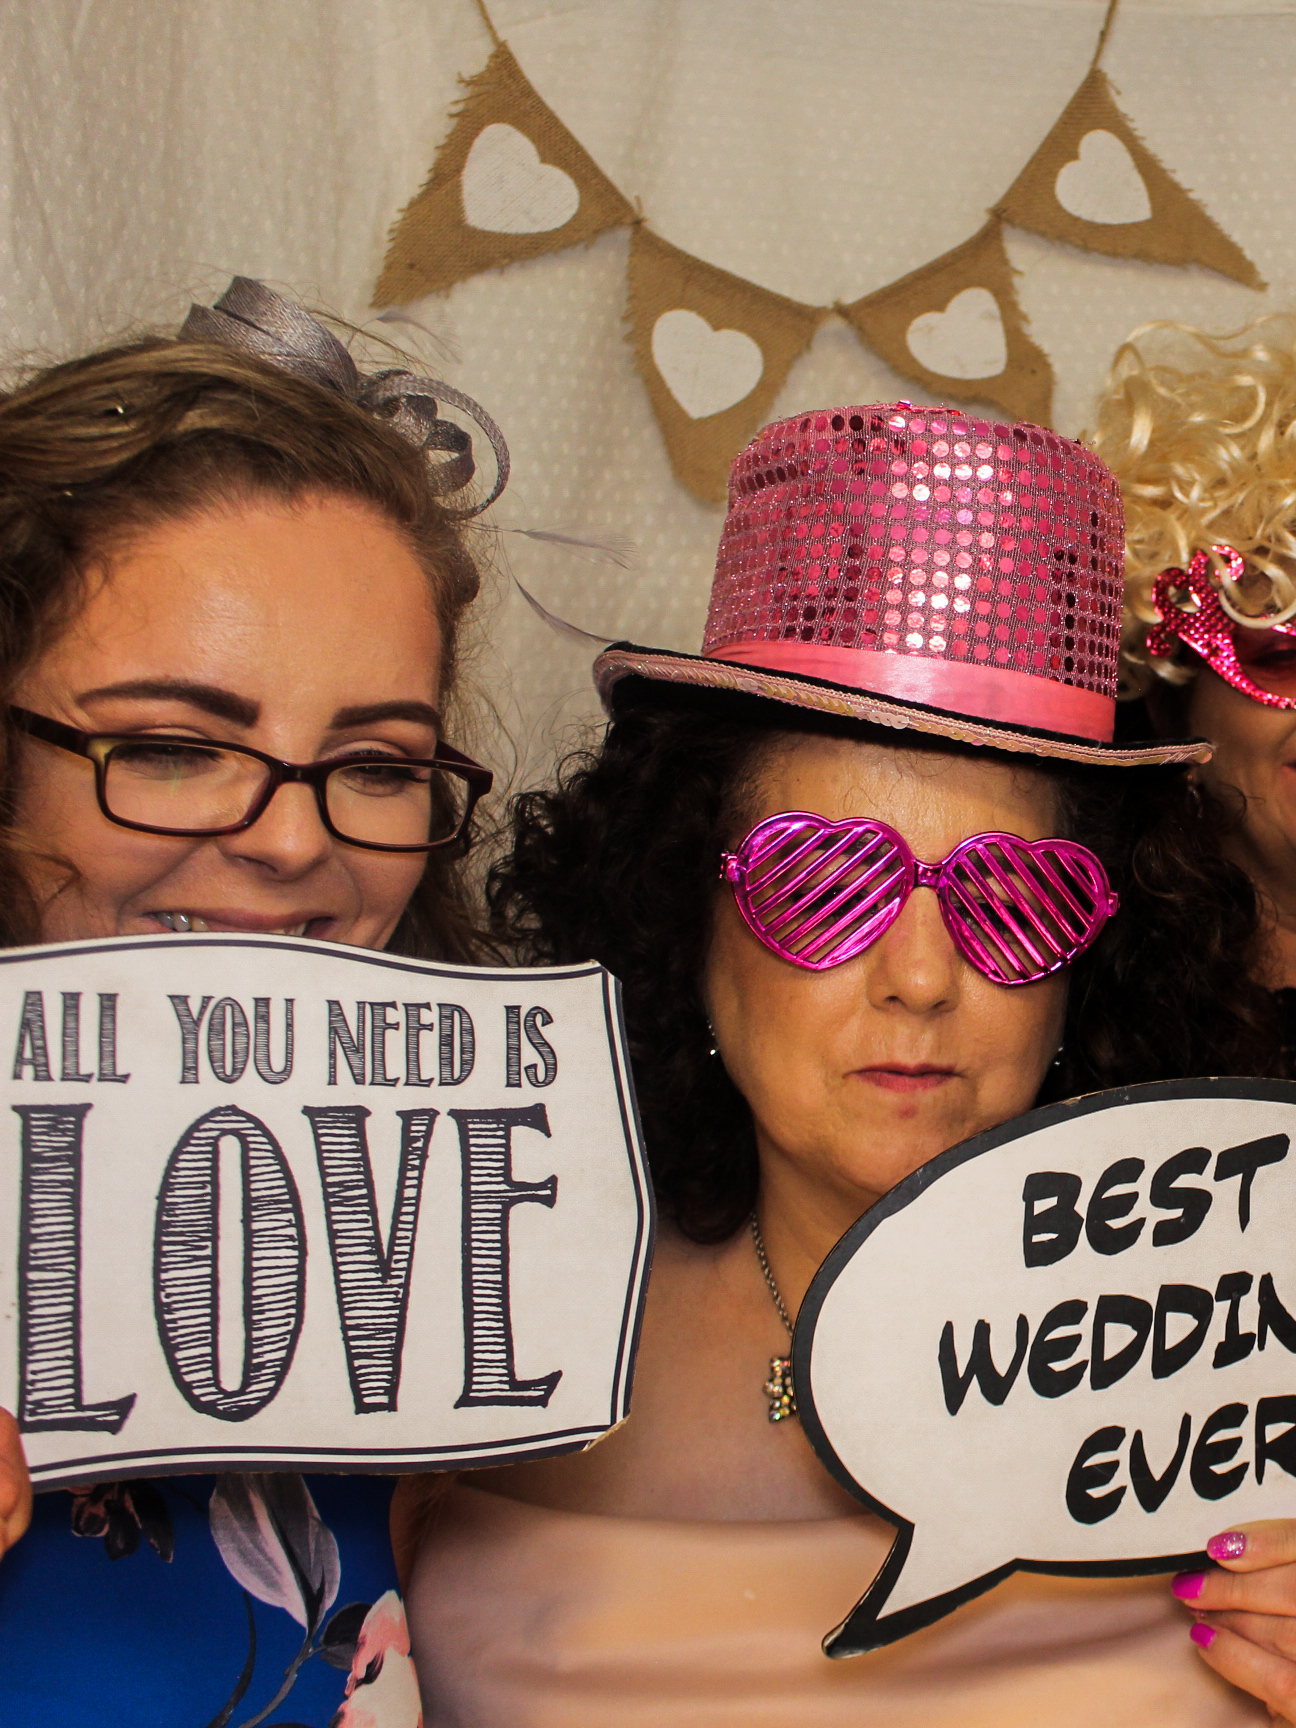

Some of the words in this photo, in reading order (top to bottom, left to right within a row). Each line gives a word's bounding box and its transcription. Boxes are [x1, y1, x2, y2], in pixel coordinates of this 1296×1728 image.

[12, 991, 130, 1083] ALL
[167, 995, 296, 1084] YOU
[326, 1000, 475, 1088] NEED
[504, 1005, 558, 1089] IS
[1022, 1133, 1290, 1268] BEST
[12, 1103, 563, 1435] LOVE
